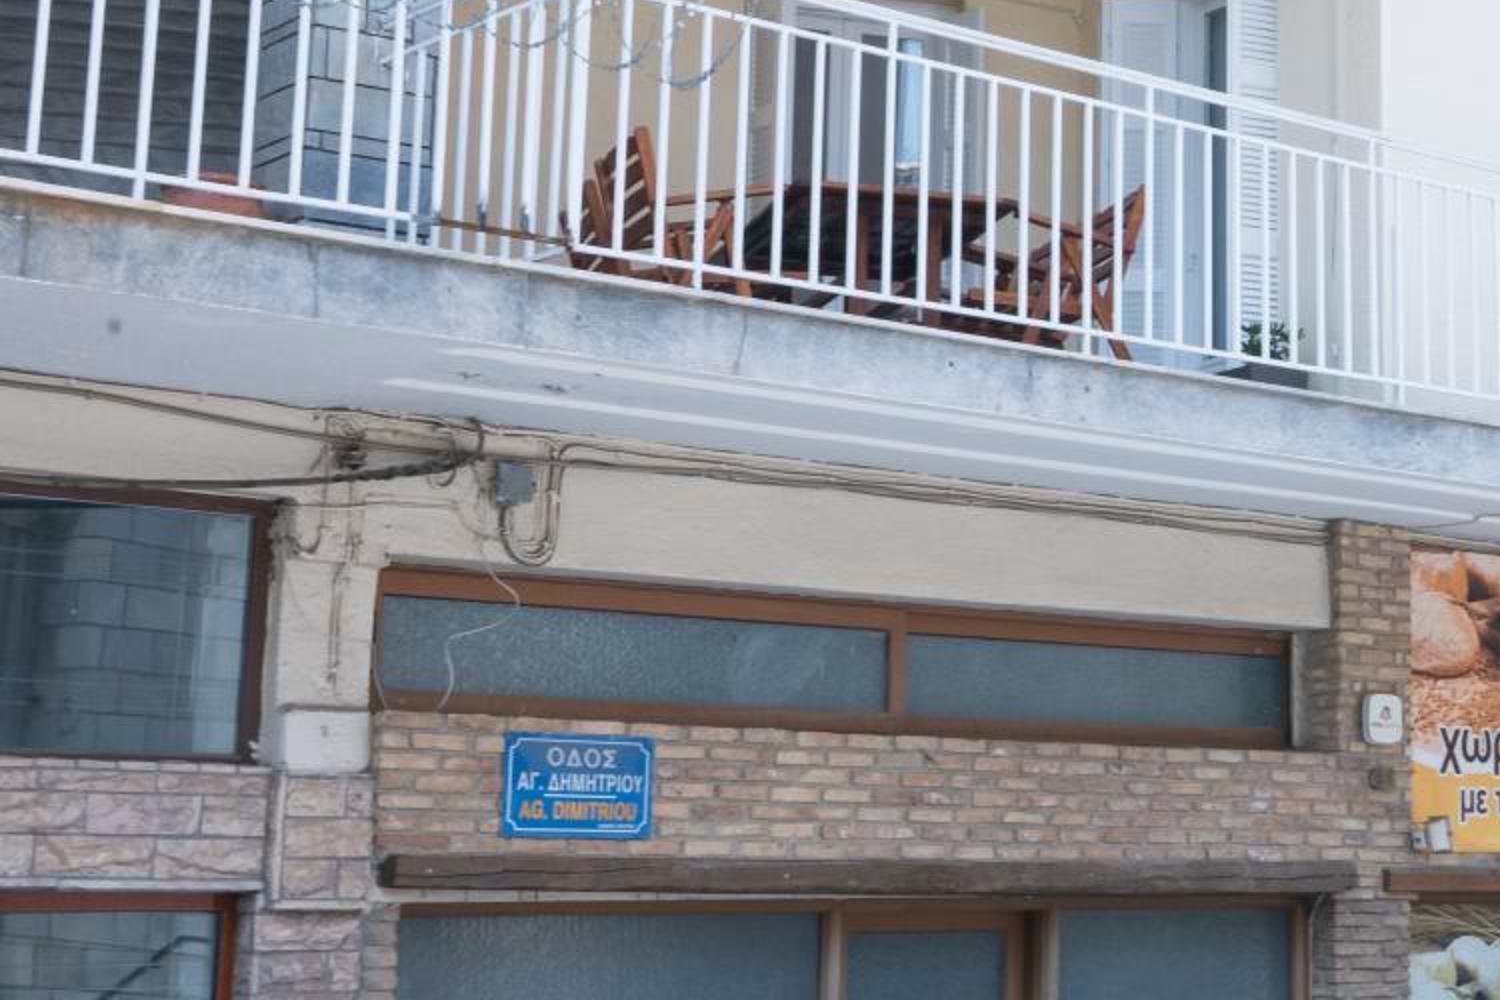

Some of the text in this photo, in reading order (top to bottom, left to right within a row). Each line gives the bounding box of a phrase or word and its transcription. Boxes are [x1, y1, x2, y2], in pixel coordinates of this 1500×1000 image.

[547, 747, 618, 768] ΟΔΟΣ
[516, 771, 643, 793] ΑΓ. ΔΗΜΗΤΡΙΟΥ
[518, 799, 638, 822] AG. DIMITRIOU
[1460, 789, 1487, 822] με
